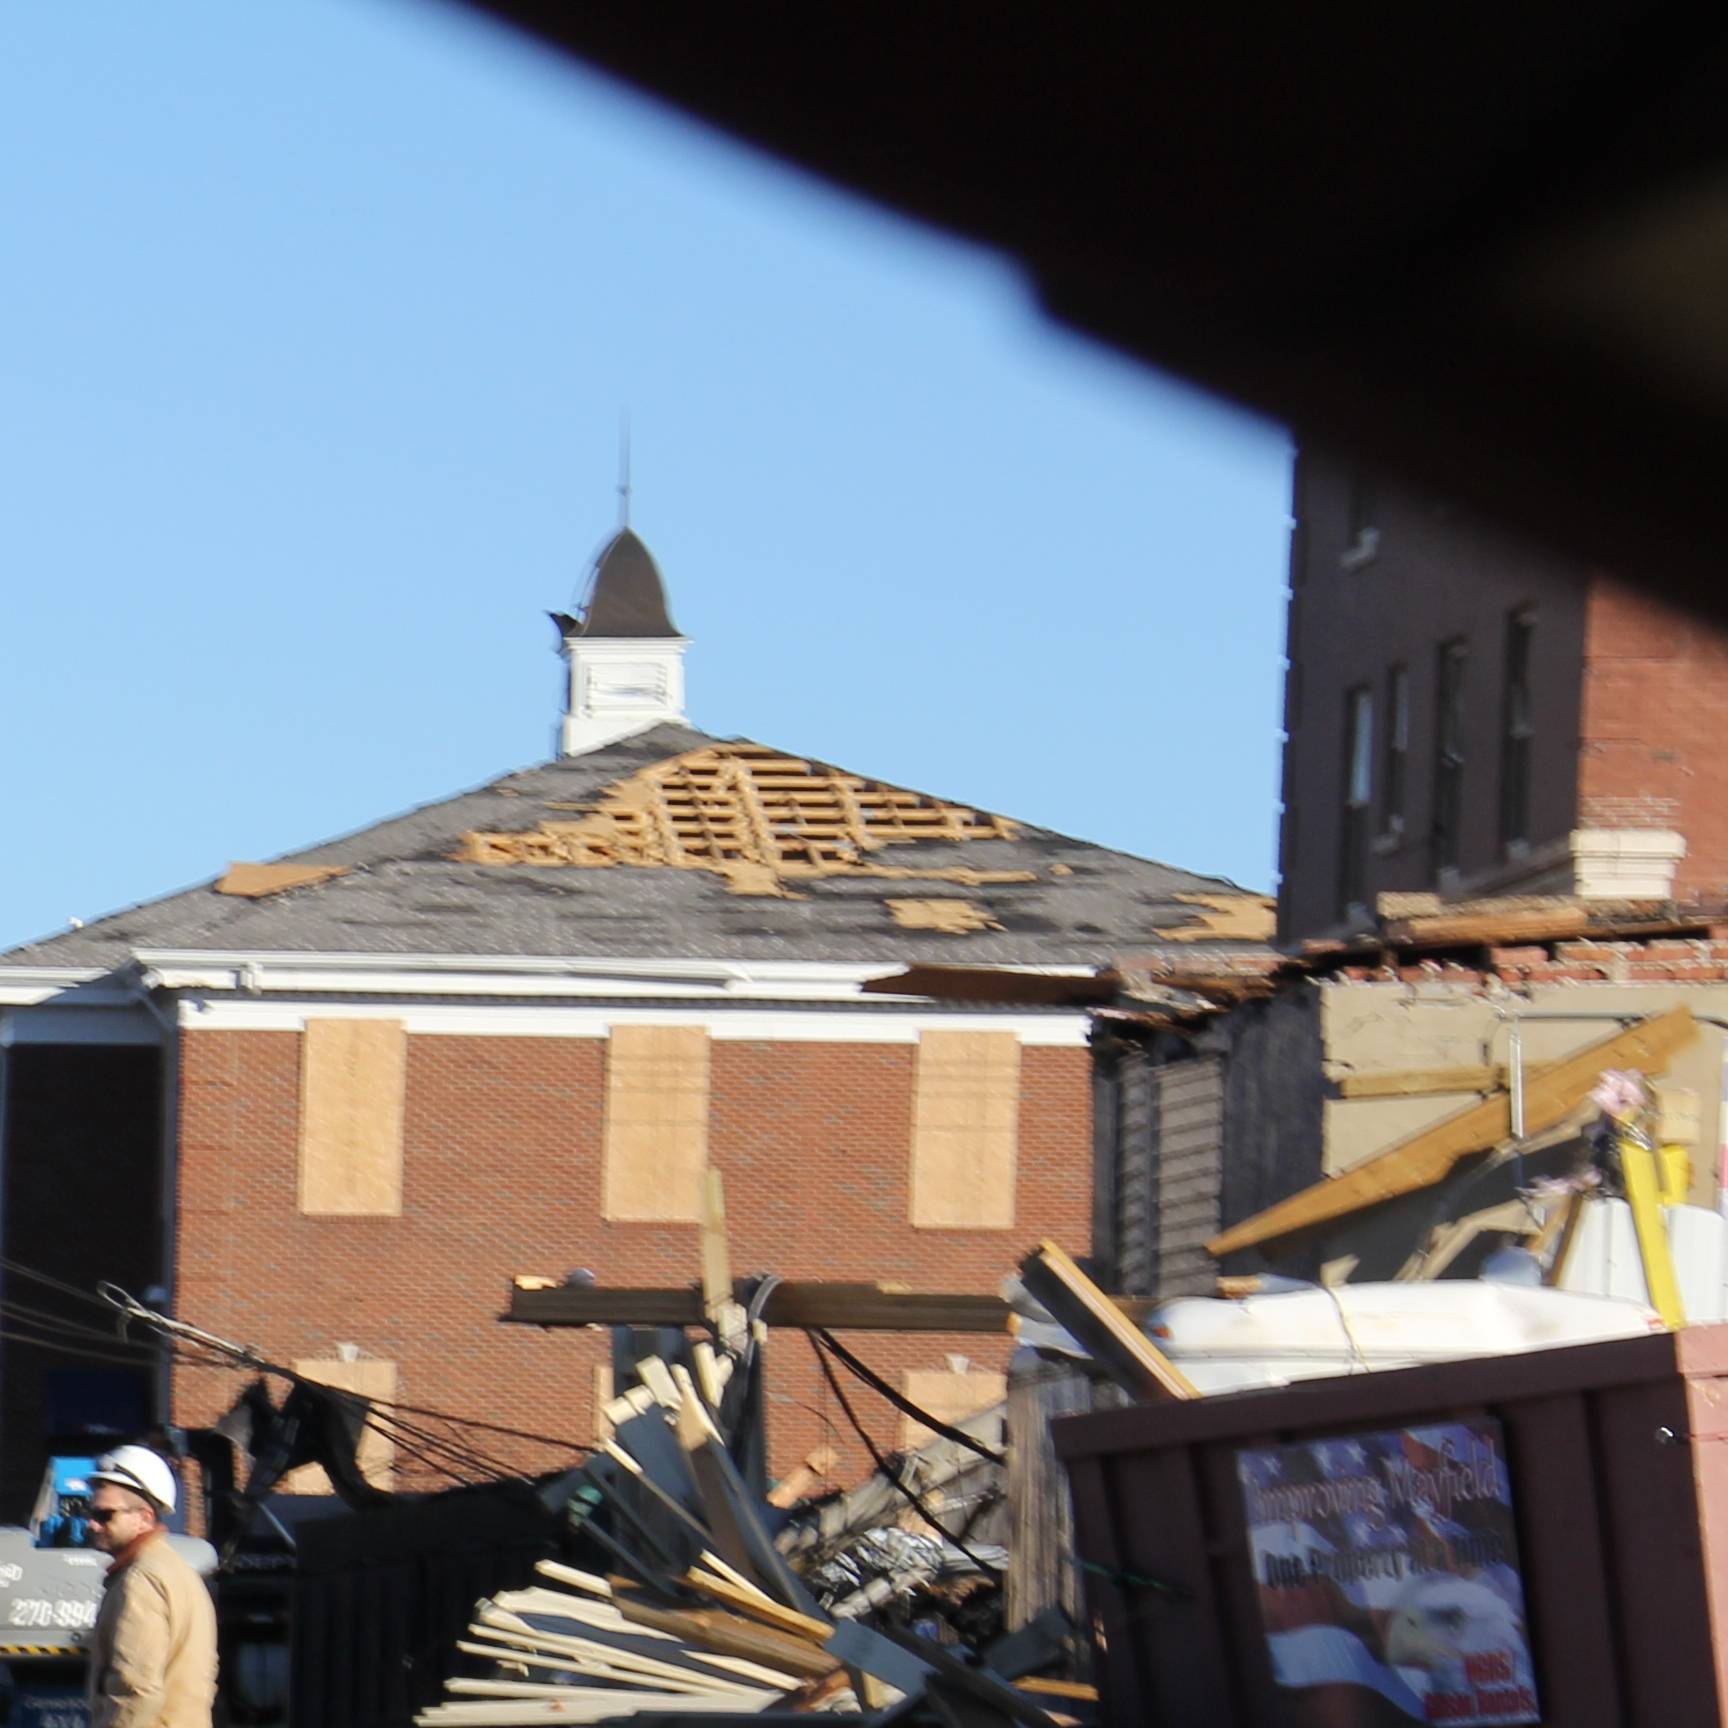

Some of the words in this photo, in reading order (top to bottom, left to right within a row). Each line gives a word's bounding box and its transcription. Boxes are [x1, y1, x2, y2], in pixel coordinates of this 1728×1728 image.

[1240, 1469, 1387, 1542] Improving
[1379, 1437, 1501, 1519] Mayfield
[1265, 1551, 1304, 1588] One
[1308, 1545, 1405, 1583] Property
